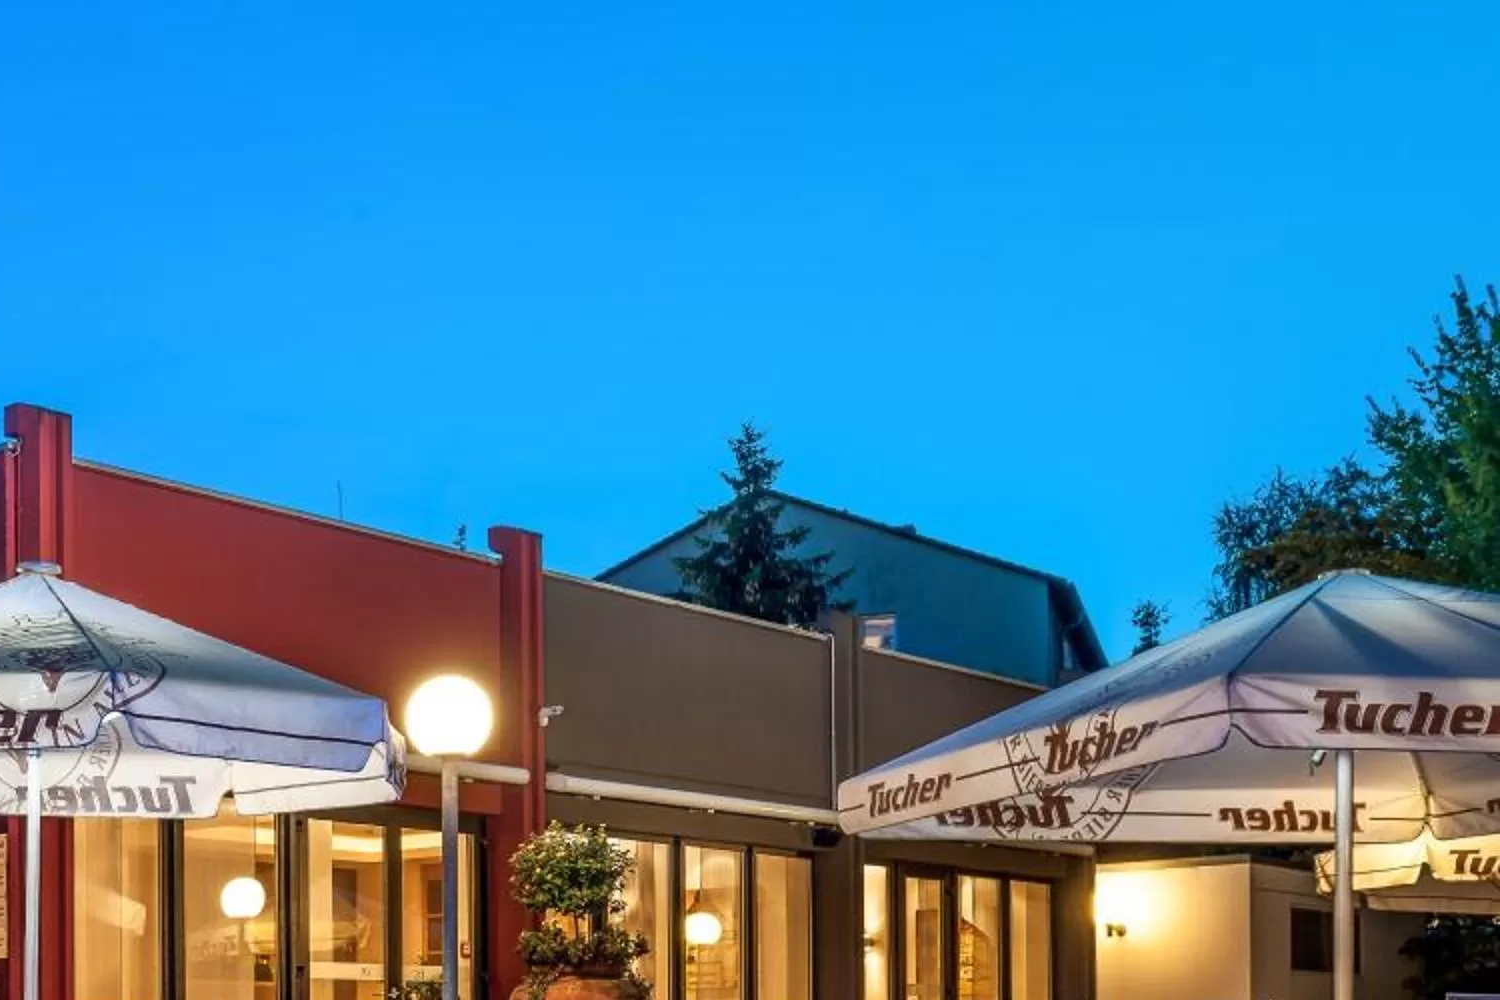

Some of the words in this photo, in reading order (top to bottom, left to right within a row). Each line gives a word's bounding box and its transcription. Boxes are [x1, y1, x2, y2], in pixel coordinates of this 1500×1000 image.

[1043, 718, 1159, 775] Tucher
[866, 773, 953, 819] Tucher
[1449, 849, 1500, 877] Tu
